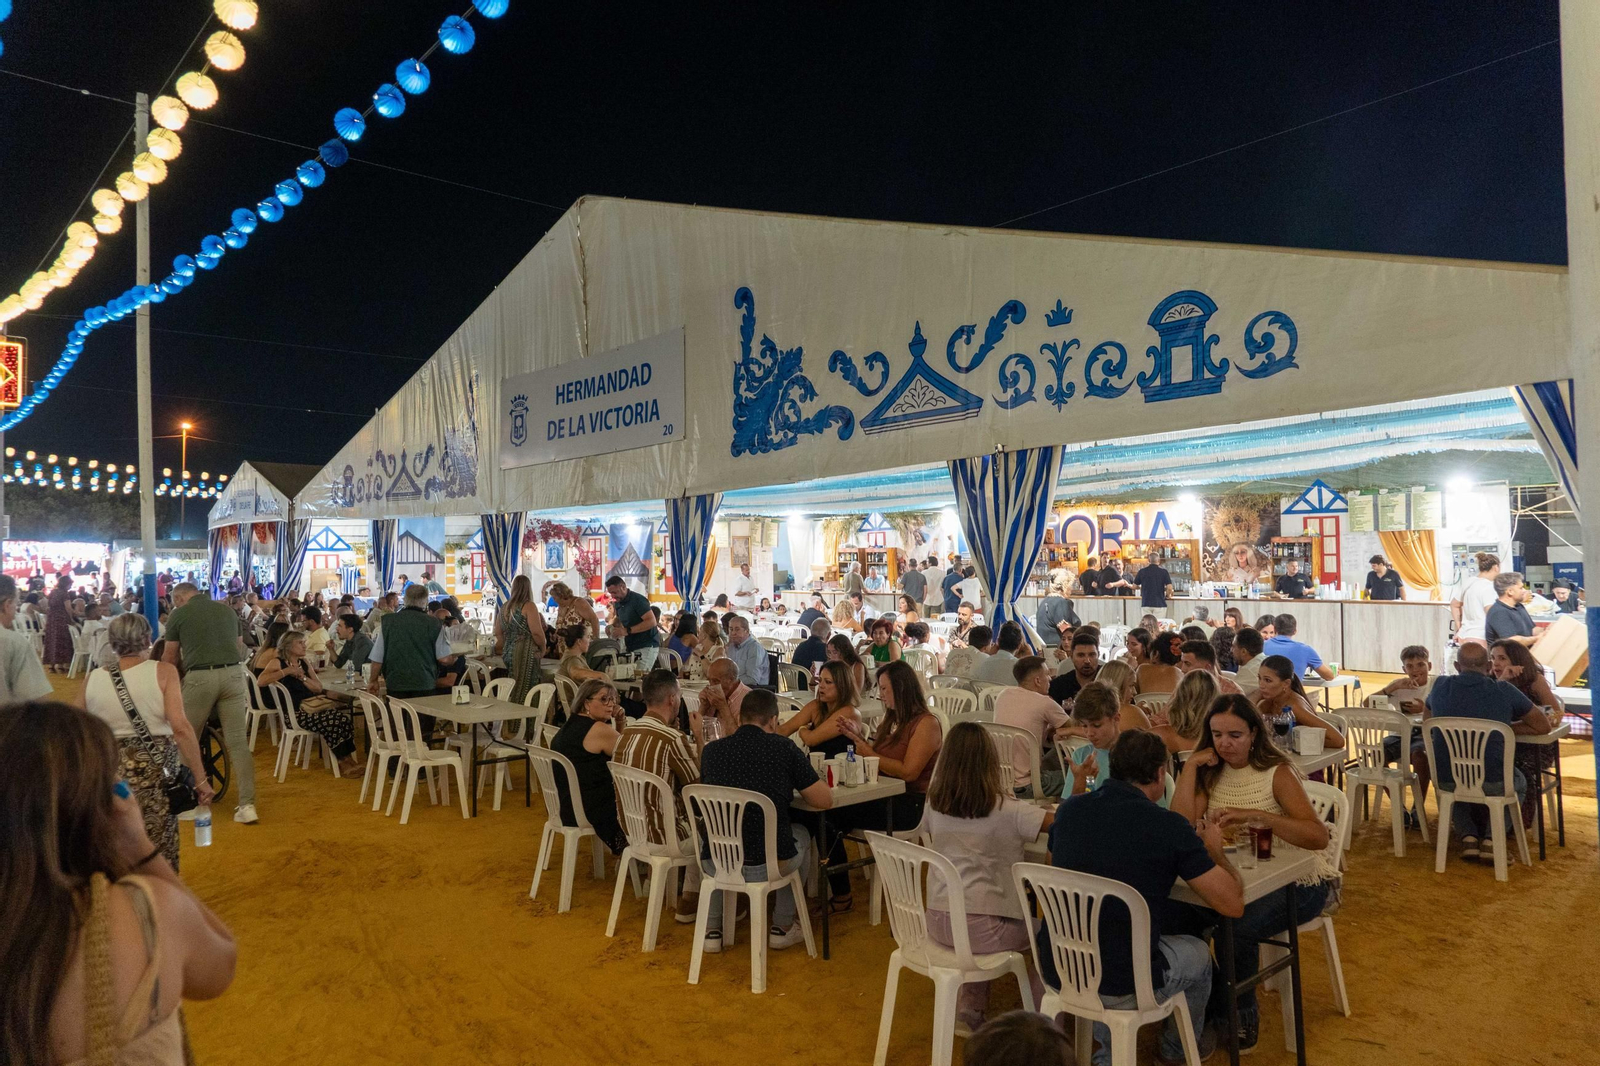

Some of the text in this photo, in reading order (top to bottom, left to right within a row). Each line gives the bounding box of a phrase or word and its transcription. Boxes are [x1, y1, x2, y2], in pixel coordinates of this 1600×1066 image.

[556, 363, 652, 405] HERMANDAD
[547, 398, 660, 441] DE LA VICTORIA
[662, 423, 674, 437] 20
[1048, 510, 1175, 557] ORIA
[116, 684, 134, 711] BIMBA
